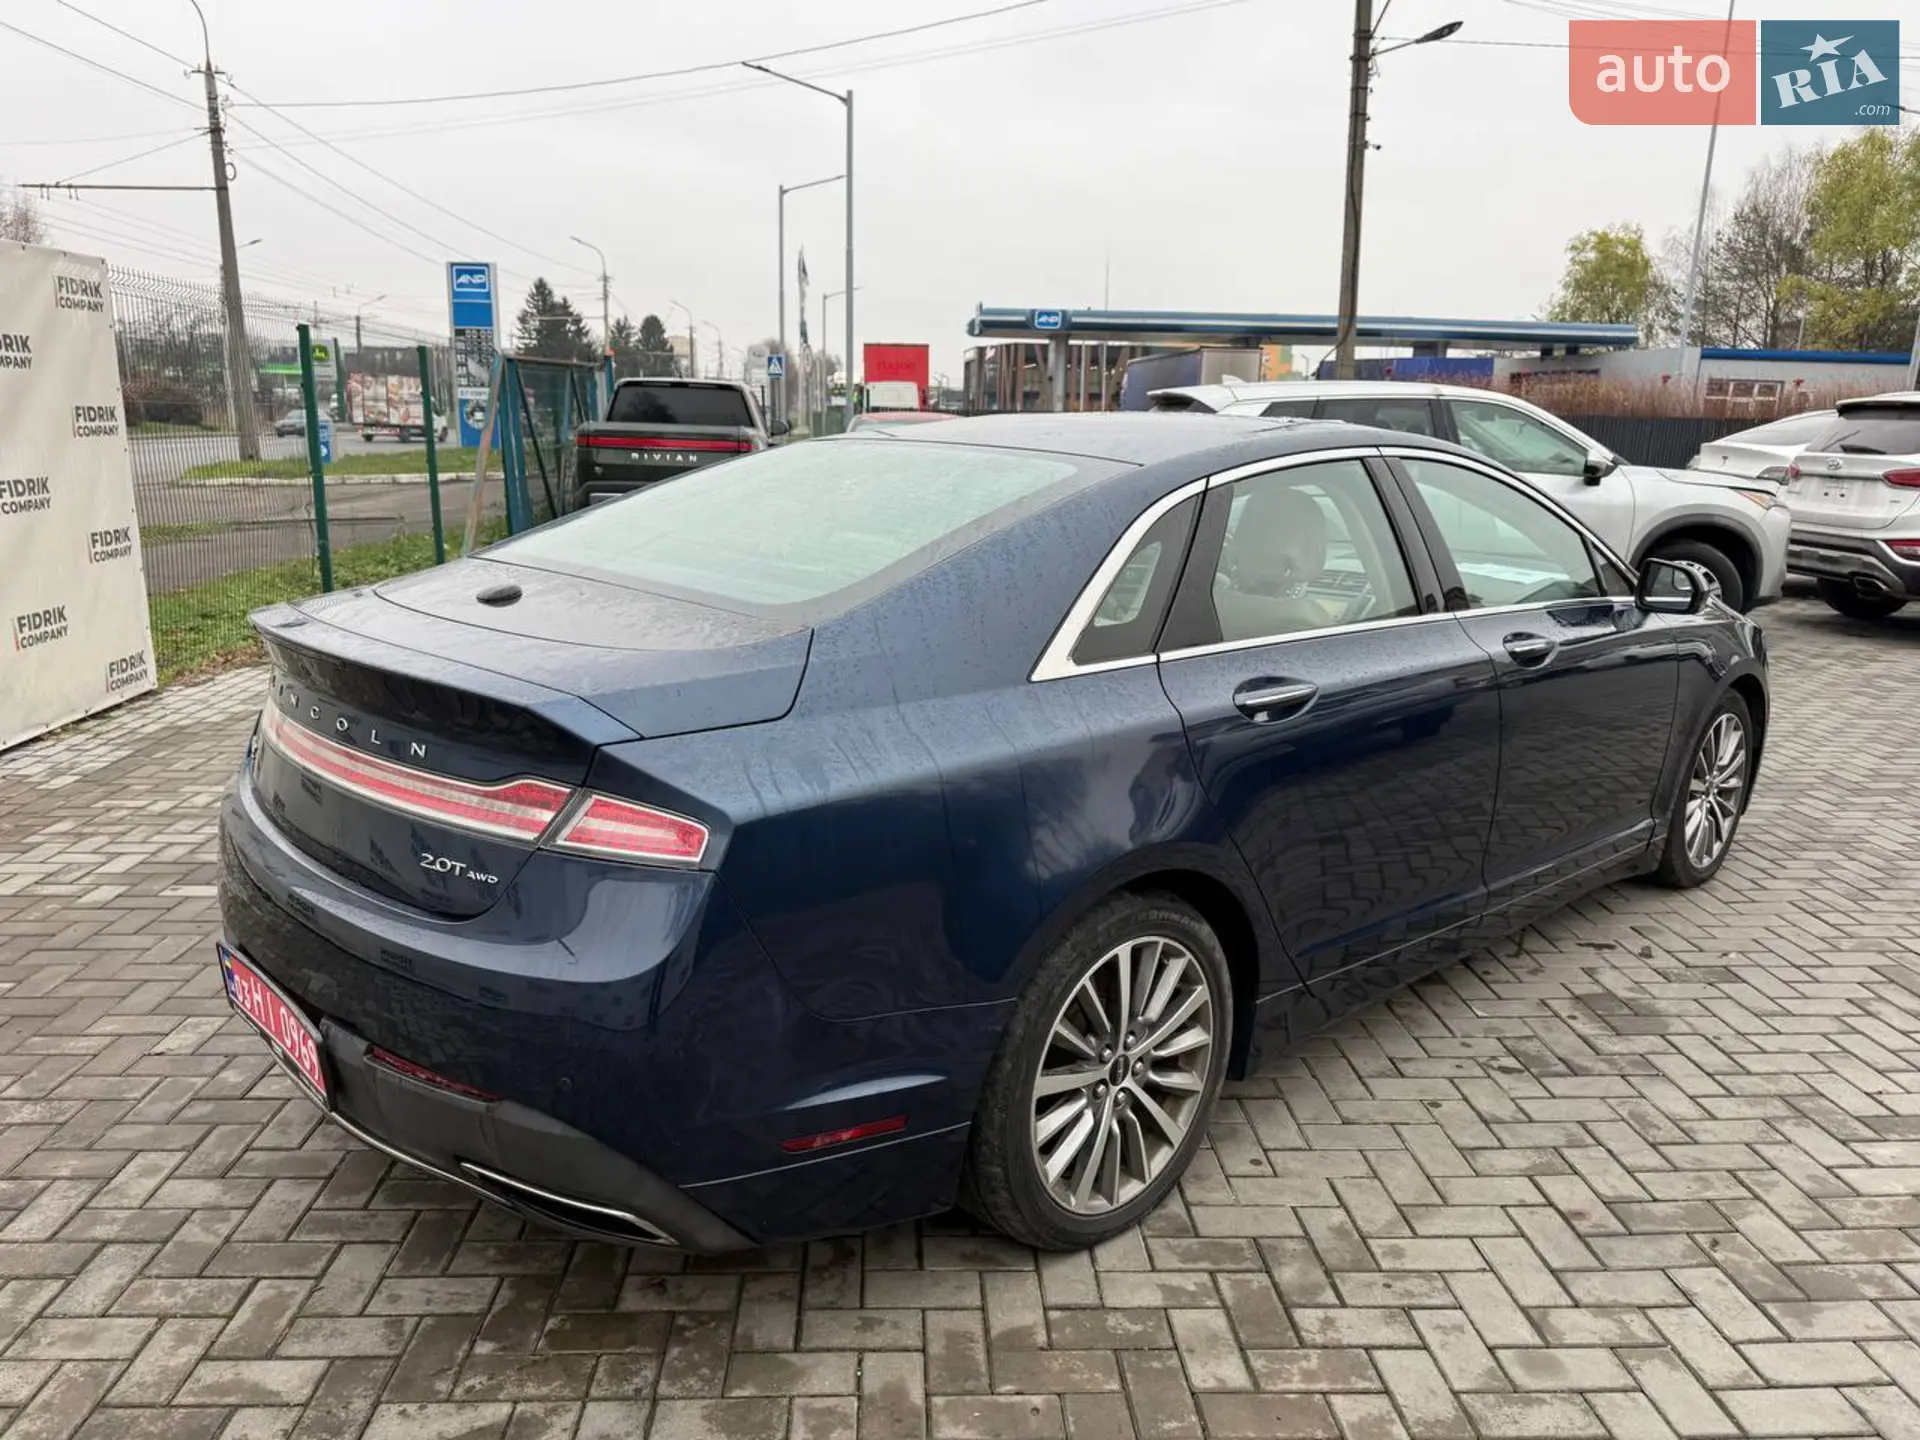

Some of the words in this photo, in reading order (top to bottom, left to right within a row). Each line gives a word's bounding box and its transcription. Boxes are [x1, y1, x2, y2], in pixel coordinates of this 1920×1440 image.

[57, 275, 103, 299] FIDRIK
[59, 296, 104, 312] COMPANY
[0, 334, 32, 353] RIK
[75, 405, 118, 423] FIDRIK
[76, 424, 119, 438] COMPANY
[631, 452, 698, 463] RIVIAN
[0, 476, 50, 499] FIDRIK
[1, 497, 51, 514] COMPANY
[91, 527, 131, 549] FIDRIK
[93, 544, 132, 563] COMPANY
[16, 605, 67, 634] FIDRIK
[20, 624, 68, 649] COMPANY
[109, 650, 147, 677] FIDRIK
[110, 667, 148, 691] COMPANY
[466, 870, 499, 884] AWD
[280, 1006, 319, 1081] 0969
